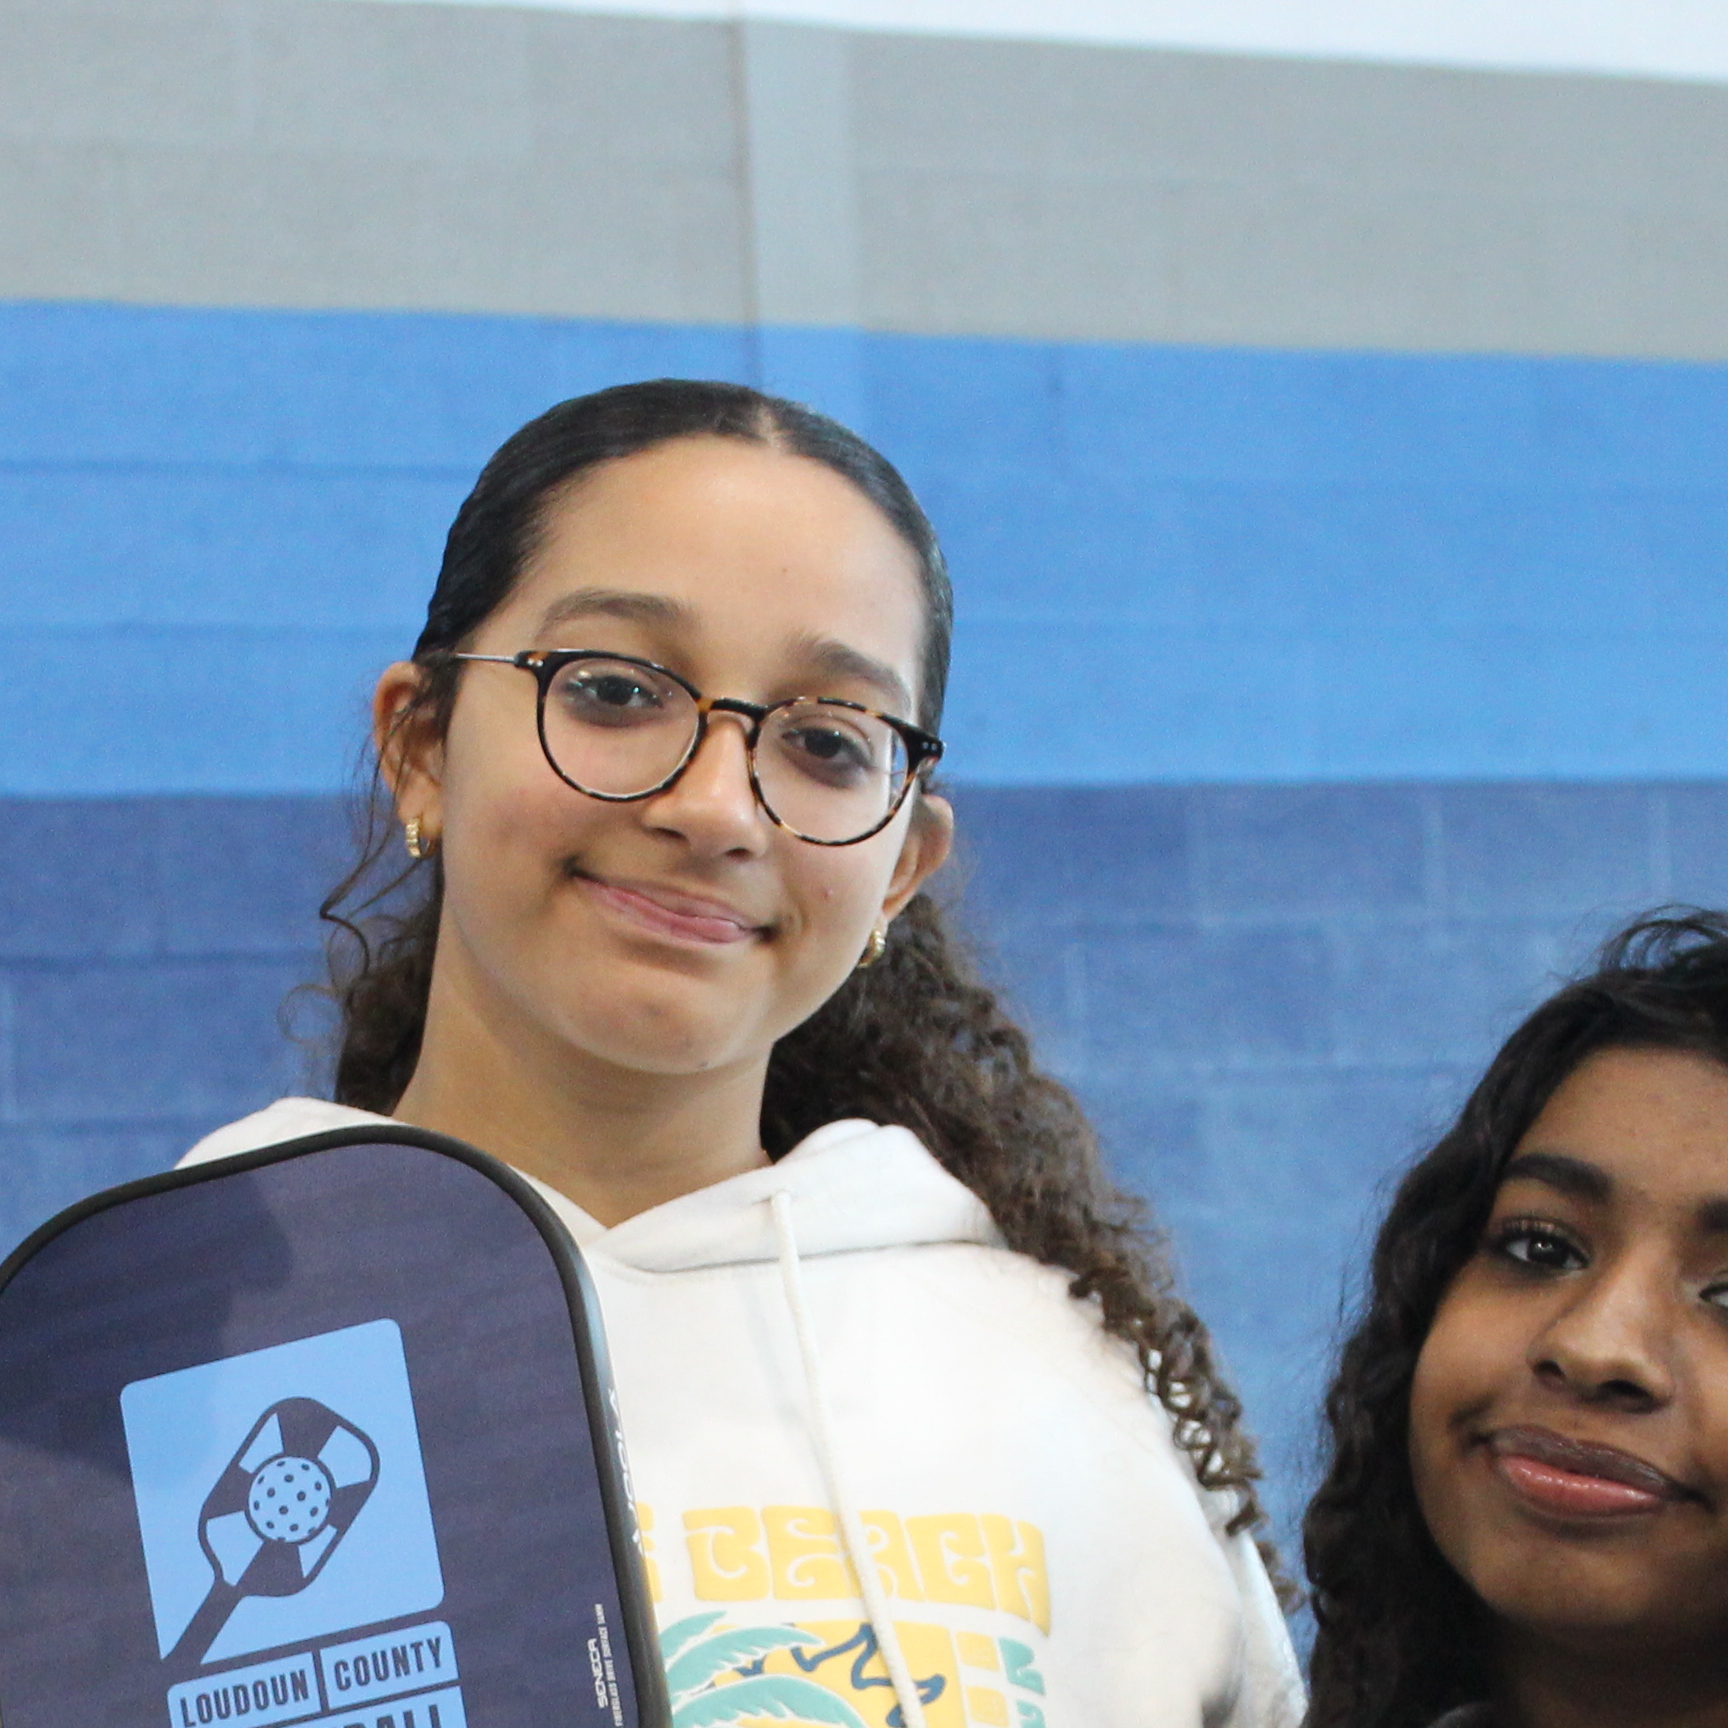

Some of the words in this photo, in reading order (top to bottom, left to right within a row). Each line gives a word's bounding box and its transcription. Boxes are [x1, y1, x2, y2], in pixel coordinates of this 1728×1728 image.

[179, 1668, 311, 1728] LOUDOUN
[333, 1636, 442, 1692] COUNTY
[587, 1637, 609, 1709] SENECA
